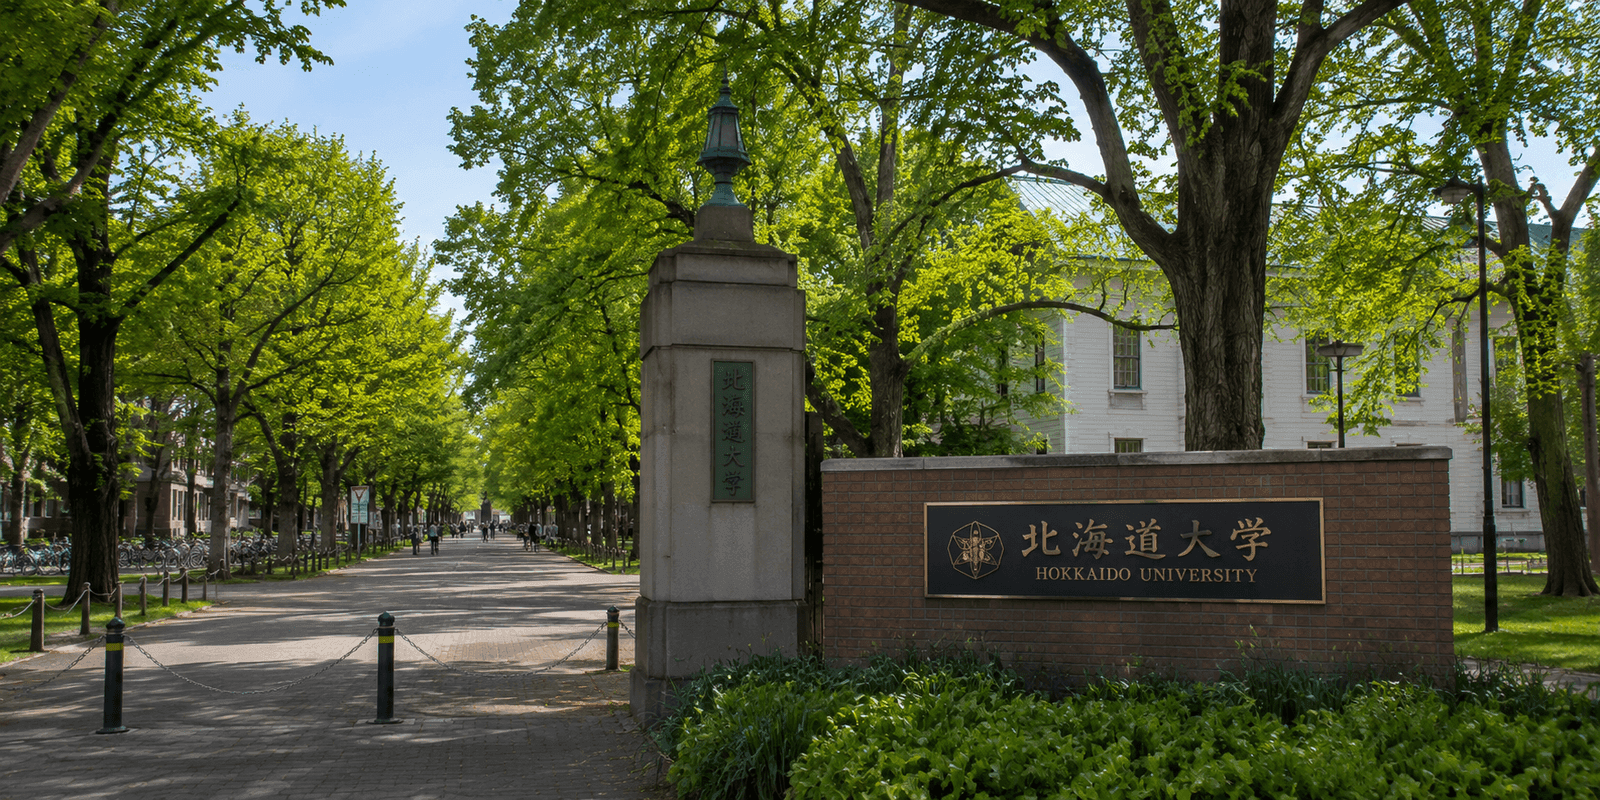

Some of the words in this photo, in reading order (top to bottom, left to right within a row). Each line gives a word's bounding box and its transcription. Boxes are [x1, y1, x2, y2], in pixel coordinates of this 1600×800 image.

[722, 368, 745, 496] 北海道大学
[1021, 518, 1272, 562] 北海道大学
[1035, 566, 1131, 581] HOKKAIDO
[1140, 567, 1258, 583] UNIVERSITY
